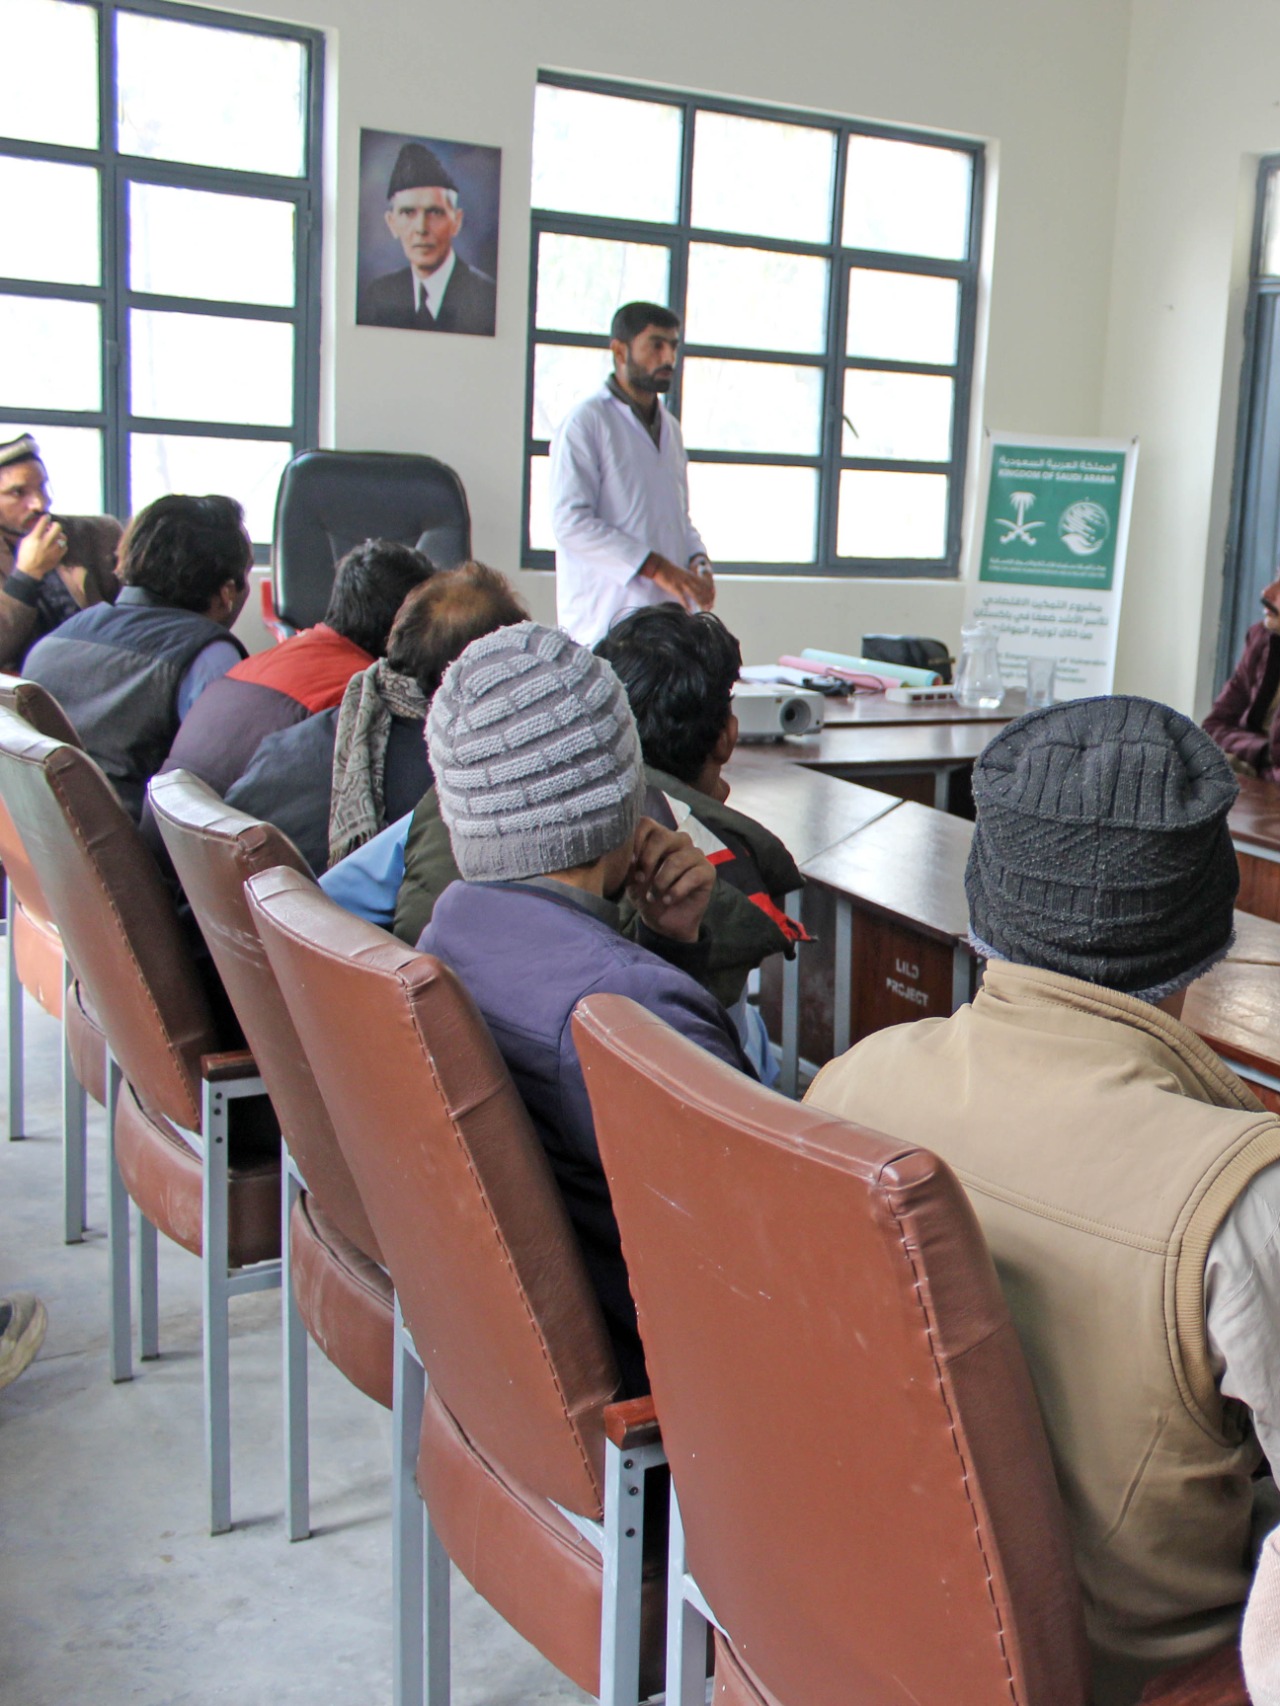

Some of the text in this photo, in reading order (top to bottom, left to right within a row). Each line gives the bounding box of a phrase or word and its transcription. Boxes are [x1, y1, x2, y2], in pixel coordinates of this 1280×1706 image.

[998, 468, 1116, 484] KINGDOM OF SAUDI ARABIA
[886, 977, 929, 1007] PROJECT
